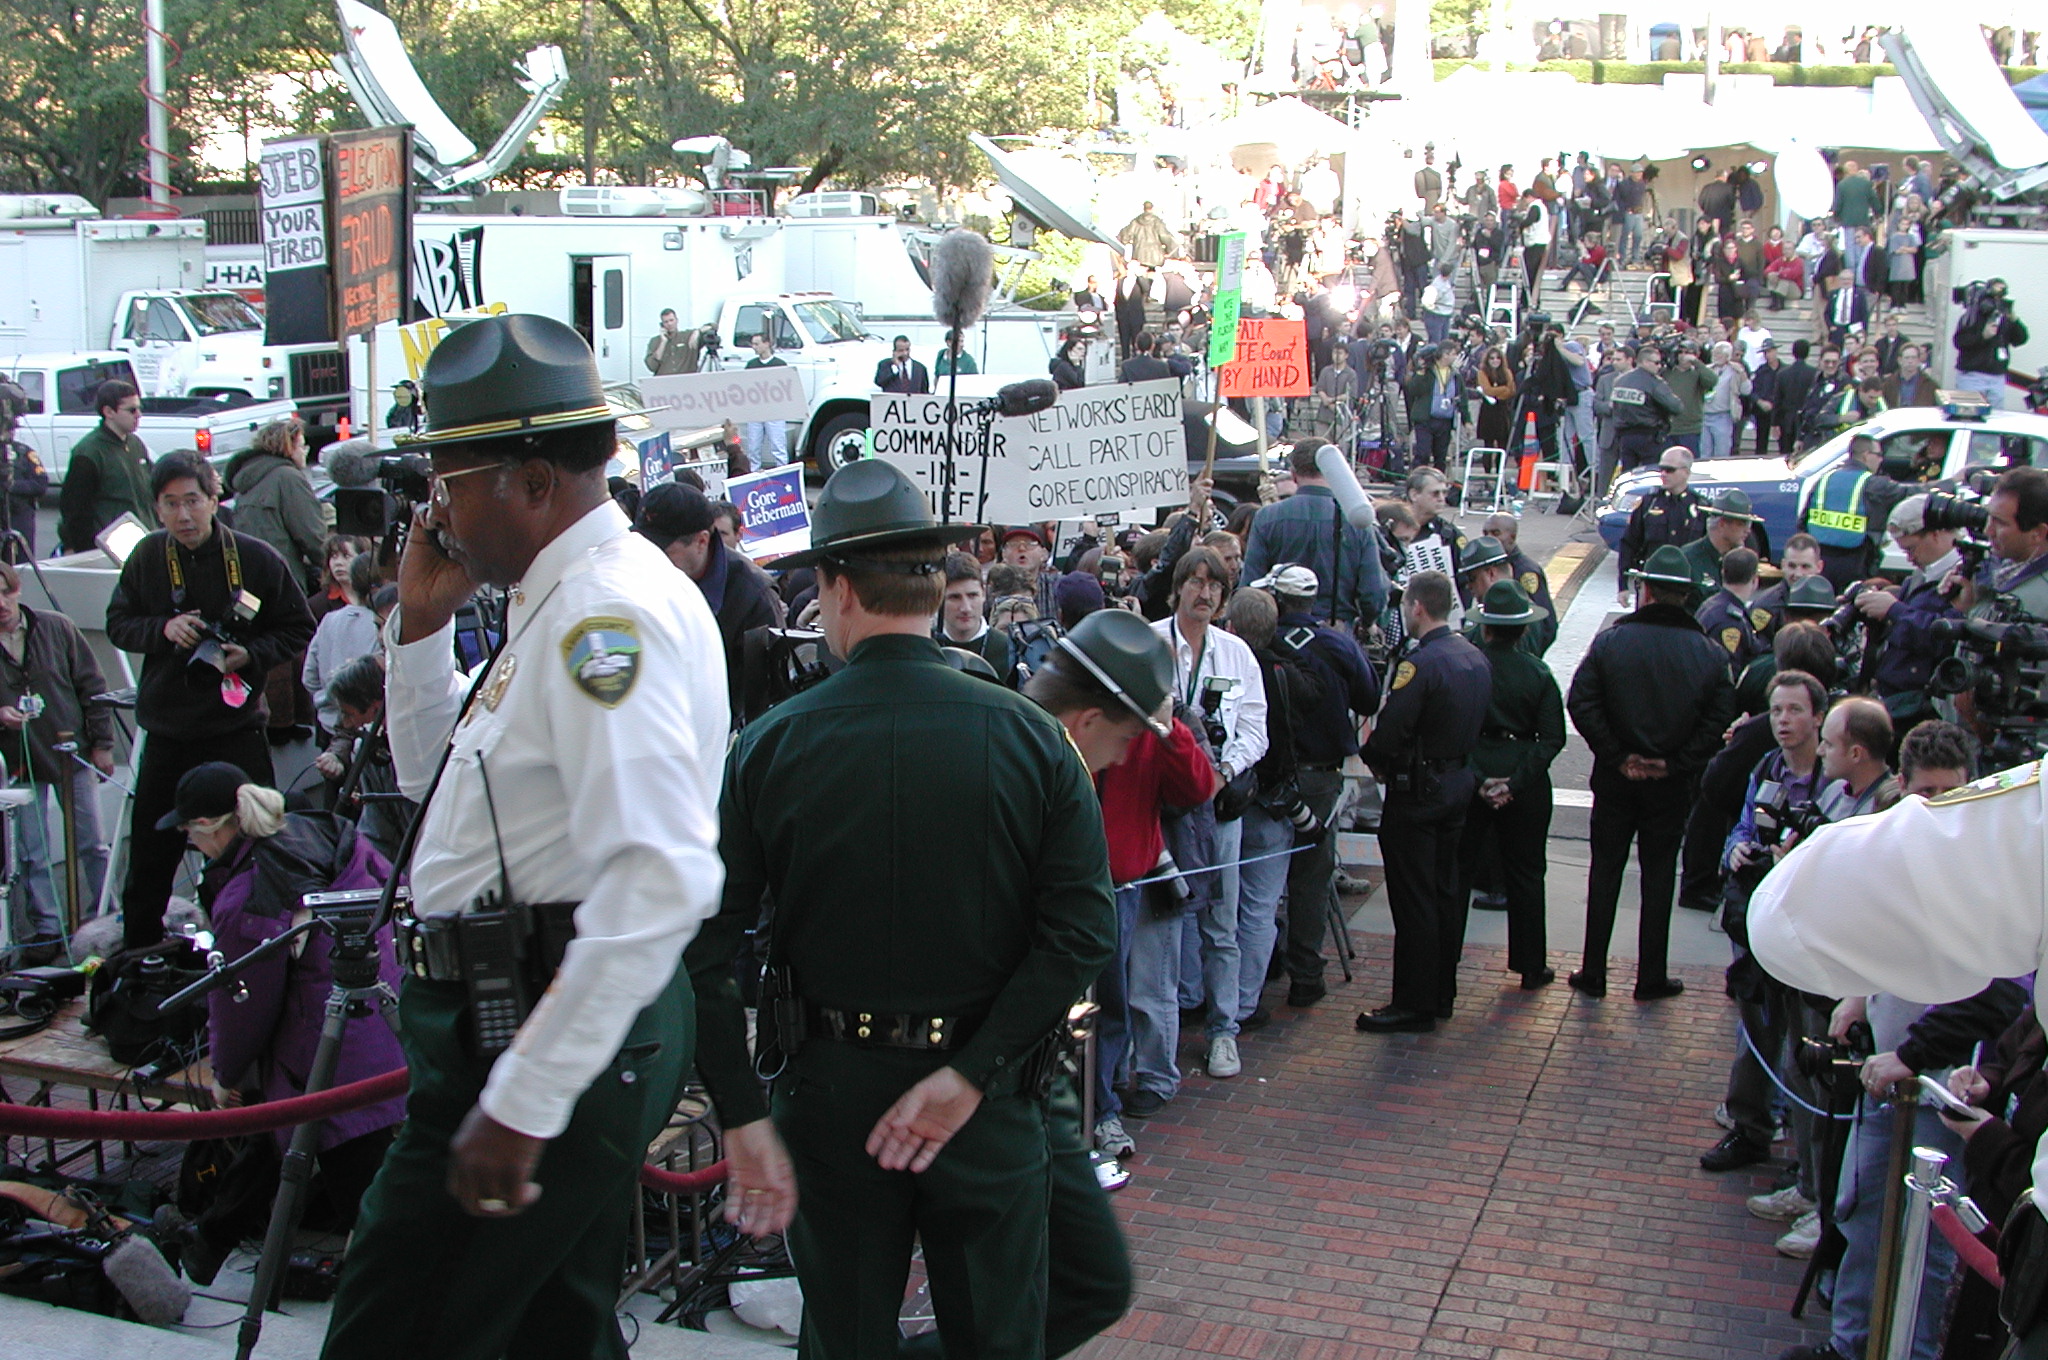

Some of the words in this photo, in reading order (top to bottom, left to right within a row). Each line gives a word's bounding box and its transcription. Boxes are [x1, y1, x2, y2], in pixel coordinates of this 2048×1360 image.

[260, 148, 321, 198] JEB
[265, 208, 321, 238] YOUR
[341, 204, 395, 275] FRAUD
[1237, 321, 1264, 340] AIR
[1224, 367, 1243, 389] BY
[1253, 365, 1300, 389] HAND
[1132, 391, 1180, 421] EARLY
[1612, 389, 1644, 402] POLICE
[884, 401, 916, 424] AL
[874, 429, 1007, 458] COMMANDER
[1029, 443, 1081, 471] CALL
[1090, 433, 1143, 465] PART
[1147, 429, 1178, 458] OF
[645, 457, 664, 476] Gore
[748, 490, 777, 509] Gore
[1029, 480, 1084, 507] GORE
[1084, 468, 1188, 502] CONSPIRACY?
[1779, 482, 1800, 493] 629
[742, 501, 804, 528] Lieberman
[1812, 511, 1862, 530] POLICE
